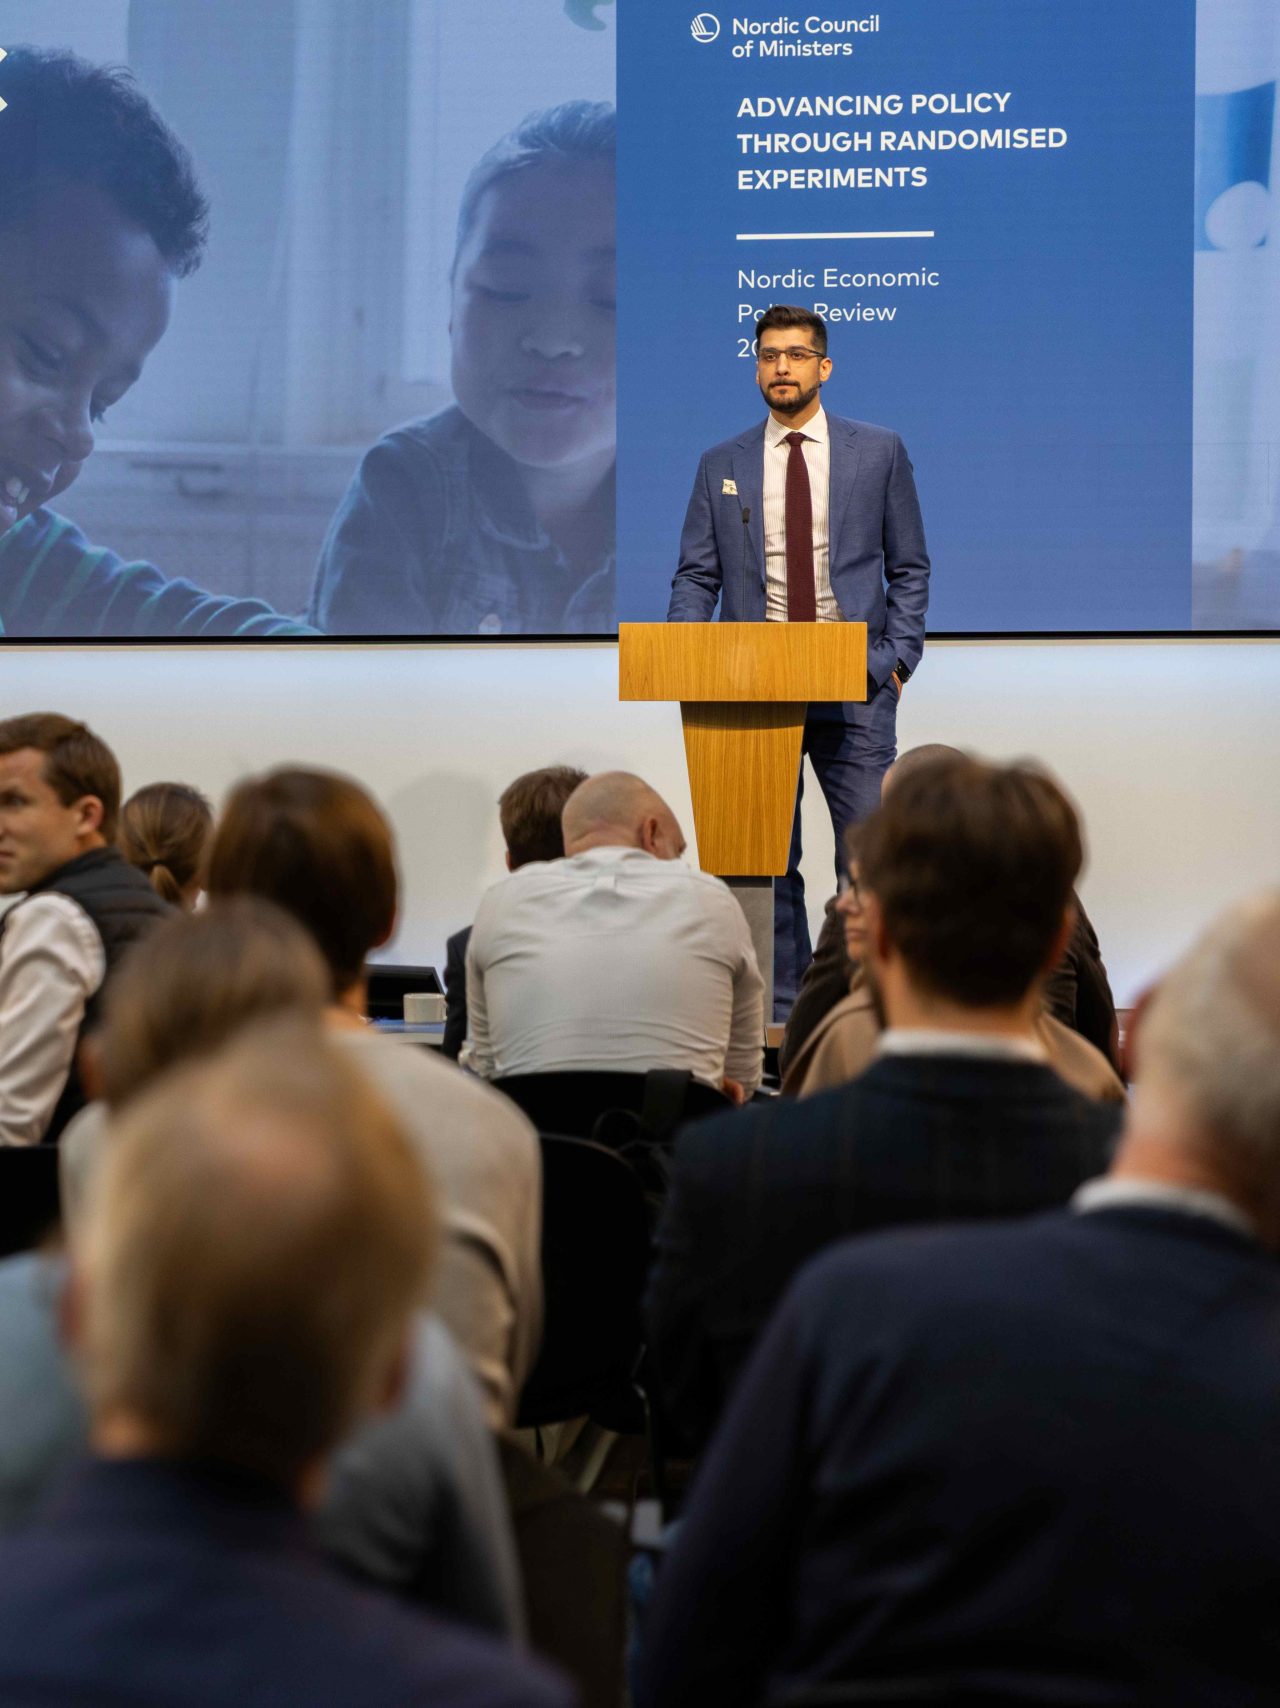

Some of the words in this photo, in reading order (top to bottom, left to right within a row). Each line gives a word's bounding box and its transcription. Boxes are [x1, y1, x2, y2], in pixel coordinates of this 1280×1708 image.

[732, 15, 800, 36] Nordic
[804, 14, 880, 34] Council
[731, 39, 754, 58] of
[759, 39, 853, 57] Ministers
[736, 94, 904, 118] ADVANCING
[911, 92, 1012, 115] POLICY
[736, 131, 872, 154] THROUGH
[880, 127, 1068, 152] RANDOMISED
[737, 166, 928, 190] EXPERIMENTS
[738, 268, 816, 289] Nordic
[823, 267, 940, 288] Economic
[813, 302, 897, 322] Review
